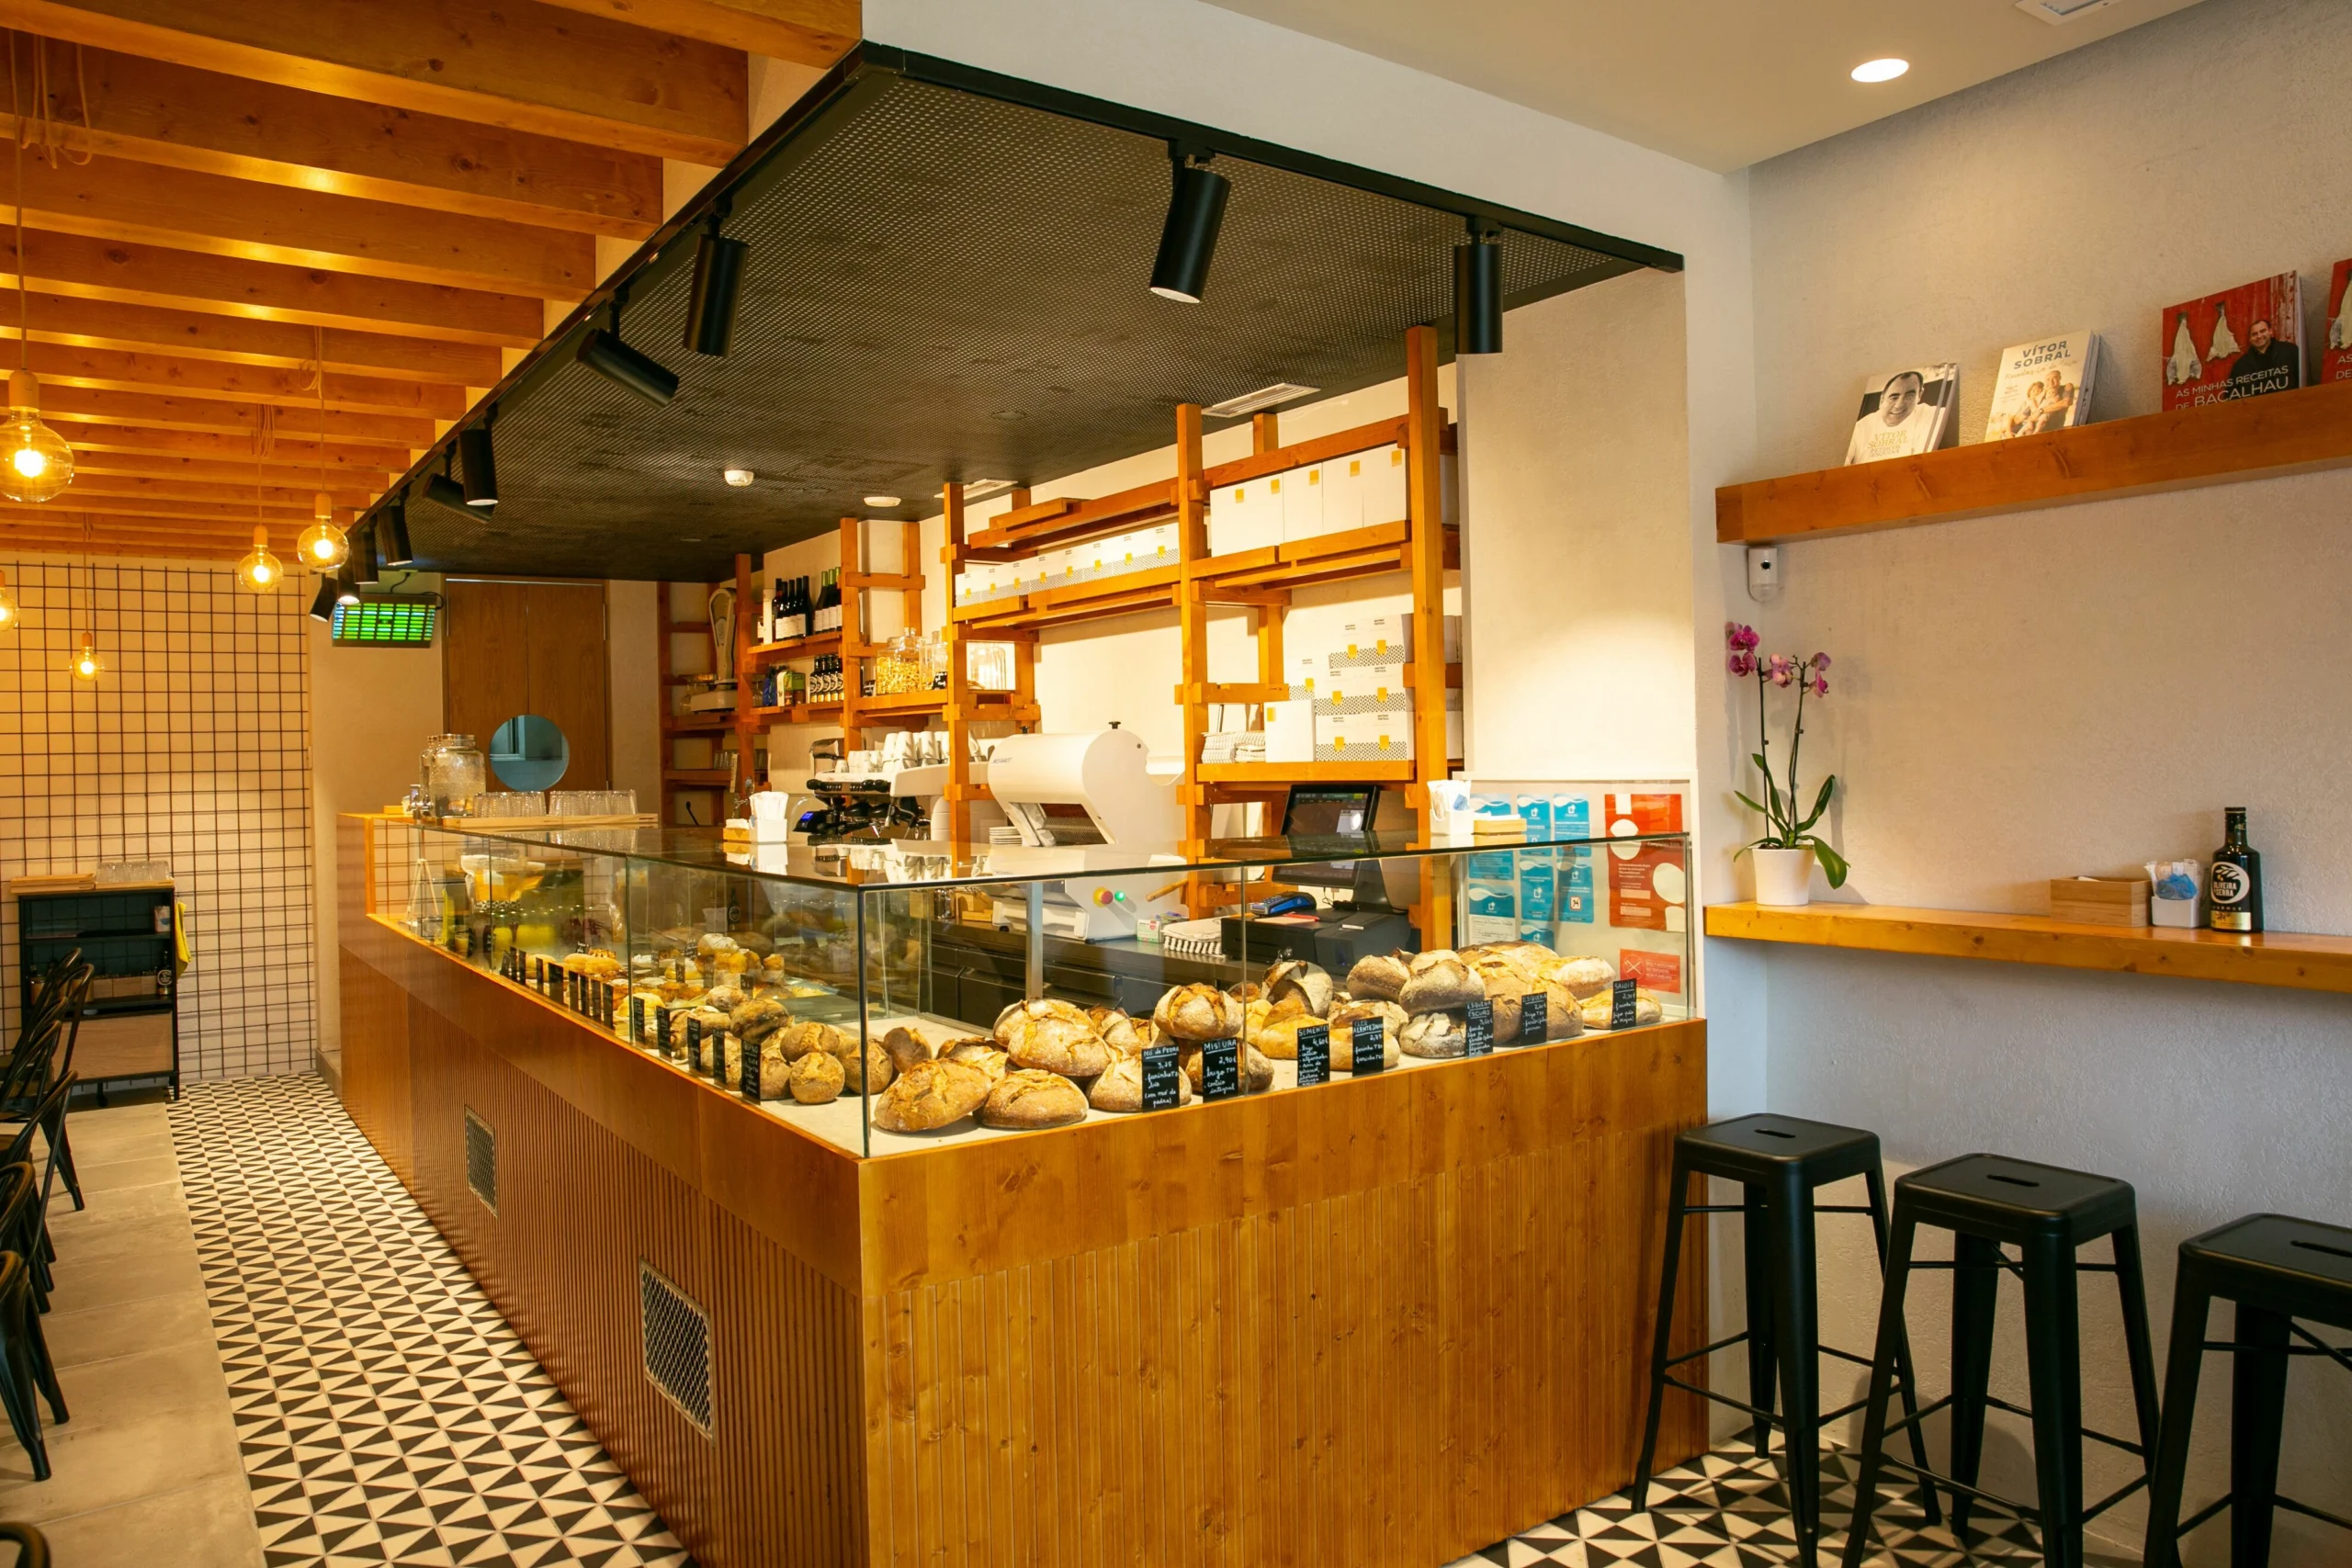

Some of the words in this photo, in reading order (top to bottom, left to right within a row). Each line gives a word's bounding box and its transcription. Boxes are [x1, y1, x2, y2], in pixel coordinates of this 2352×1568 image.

[2023, 340, 2068, 358] VÍTOR
[2014, 349, 2071, 369] SOBRAL
[2337, 354, 2352, 364] AS
[2336, 369, 2352, 379] DE
[2176, 389, 2190, 399] AS
[2192, 378, 2233, 395] MINHAS
[2235, 366, 2290, 385] RECEITAS
[2194, 376, 2290, 408] BACALHAU
[1867, 436, 1908, 449] SOBRAL
[1298, 1025, 1329, 1036] SEMENTES
[1204, 1040, 1237, 1051] MISTURA
[1218, 1056, 1237, 1065] 2,90€
